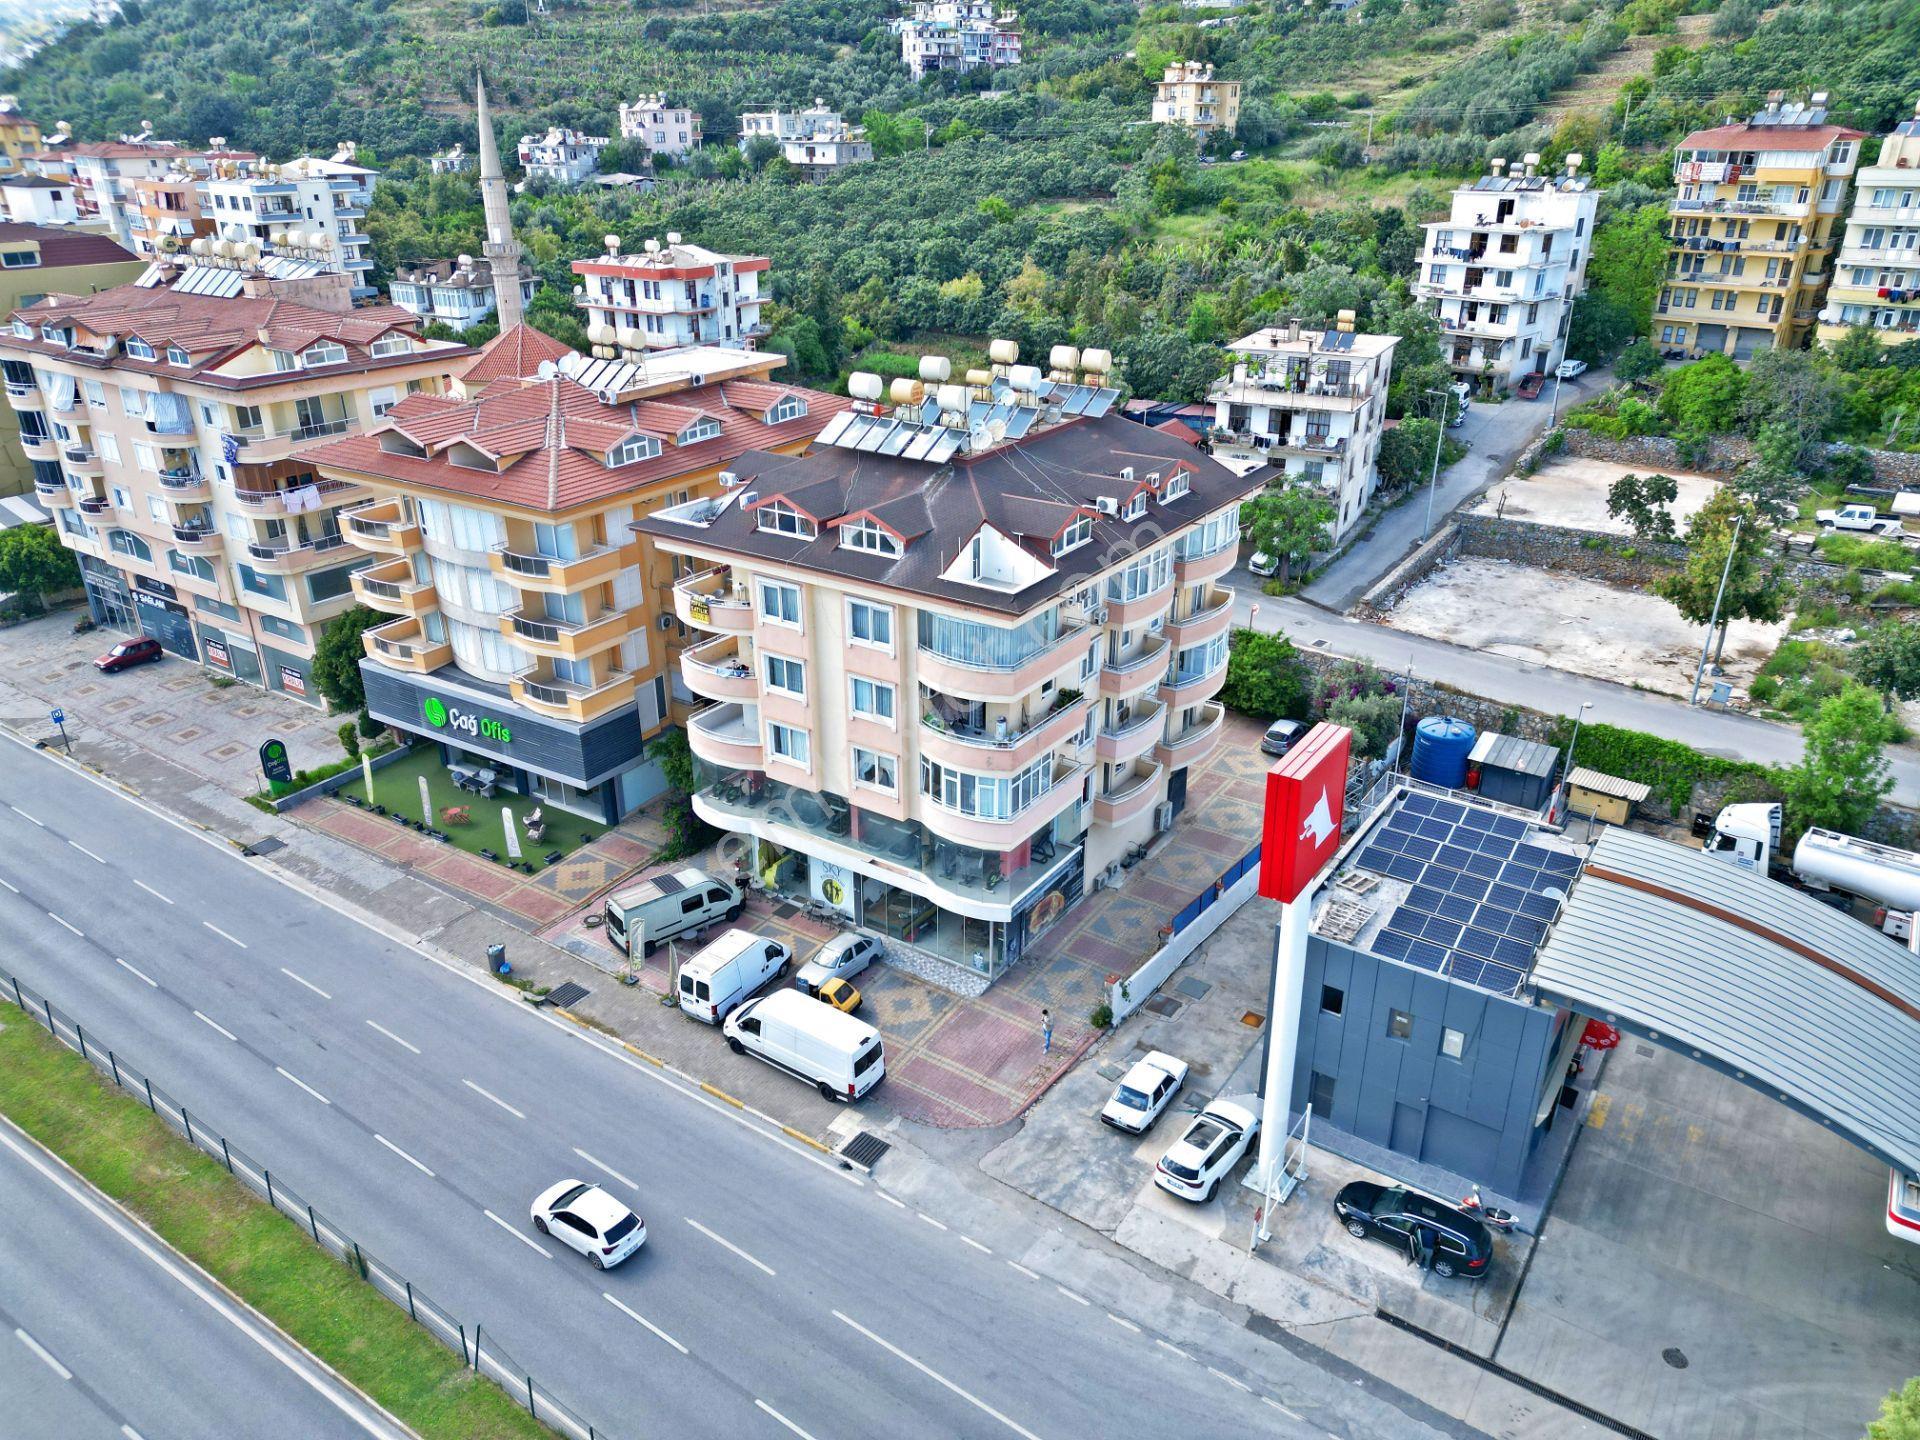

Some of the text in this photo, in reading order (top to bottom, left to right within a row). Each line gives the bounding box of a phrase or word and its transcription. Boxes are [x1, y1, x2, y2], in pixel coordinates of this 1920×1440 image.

[449, 707, 512, 743] Çağ Ofis
[822, 861, 843, 877] SKY
